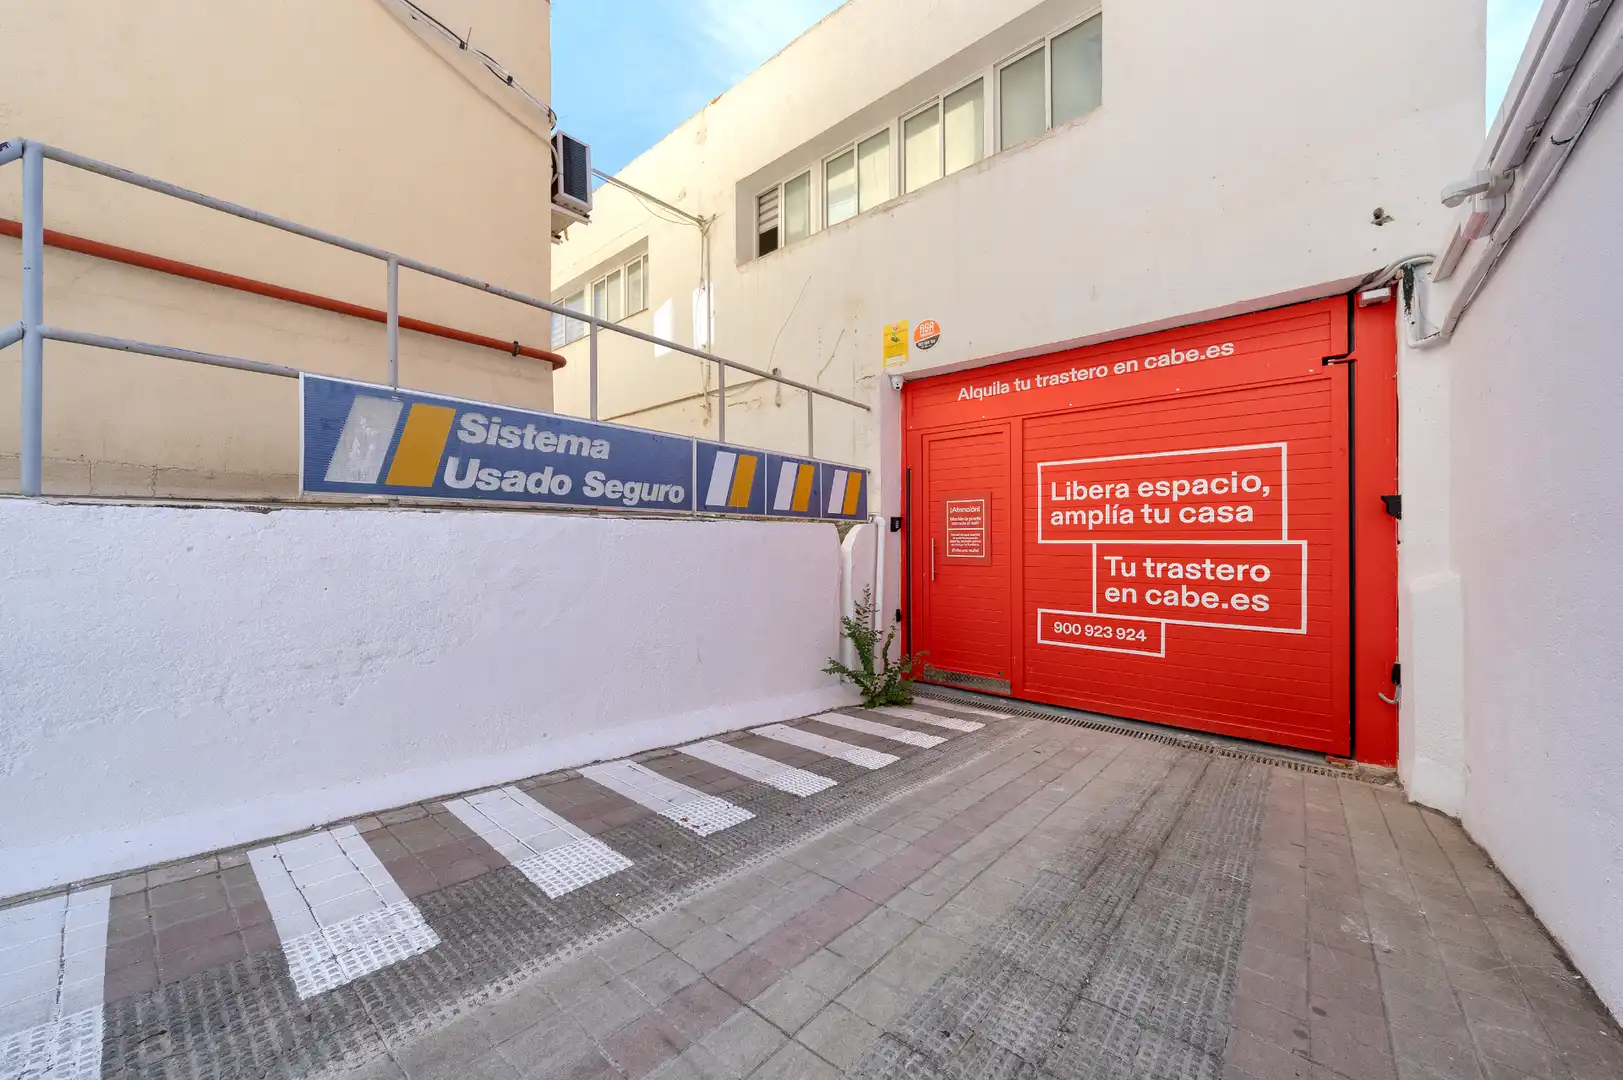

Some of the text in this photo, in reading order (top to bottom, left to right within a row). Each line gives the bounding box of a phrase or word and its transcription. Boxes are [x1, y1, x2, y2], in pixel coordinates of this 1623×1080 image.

[957, 342, 1235, 402] Alquila tu trastero en cabe.es
[456, 412, 611, 460] Sistema
[443, 456, 686, 506] Usado Seguro
[1051, 470, 1270, 502] Libera espacio,
[1050, 503, 1254, 530] amplía tu casa
[1103, 555, 1271, 582] Tu trastero
[1104, 584, 1270, 612] en cabe.es
[1053, 621, 1147, 642] 900 923 924
